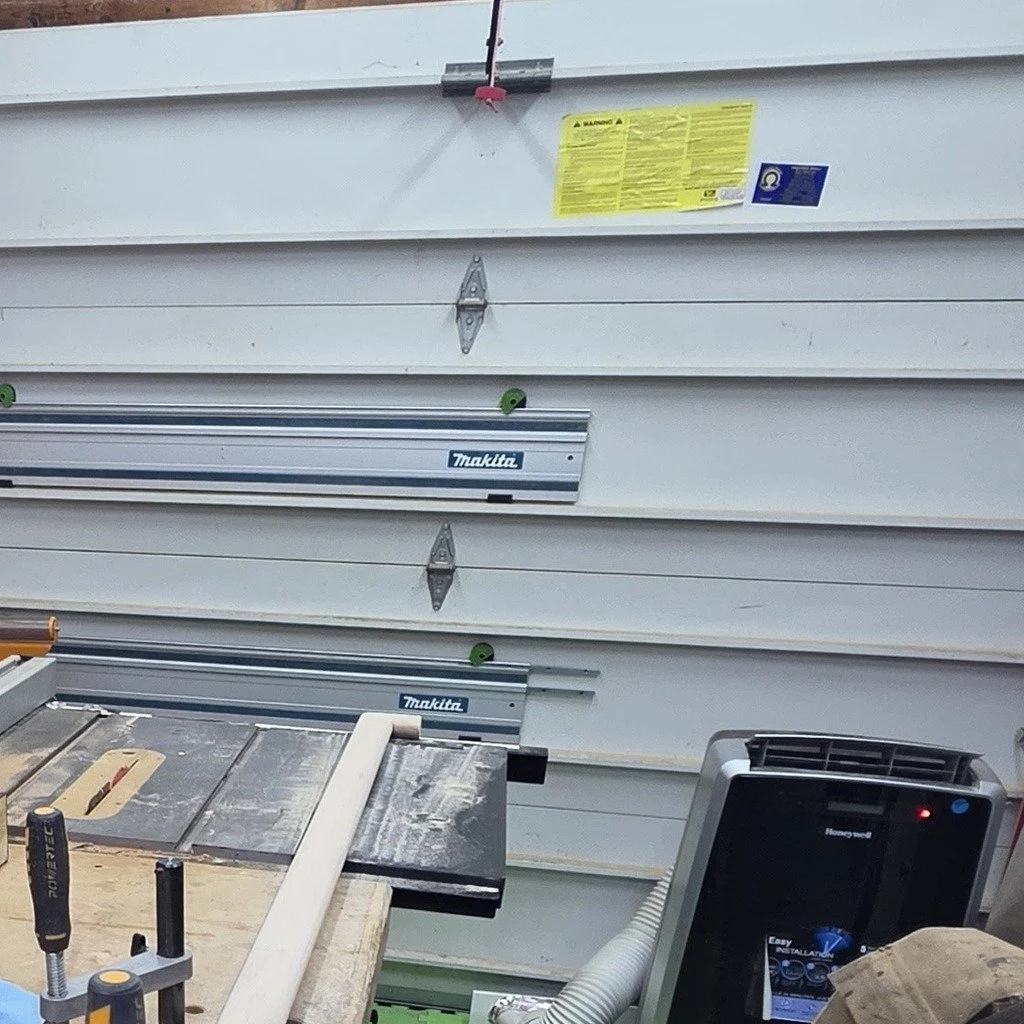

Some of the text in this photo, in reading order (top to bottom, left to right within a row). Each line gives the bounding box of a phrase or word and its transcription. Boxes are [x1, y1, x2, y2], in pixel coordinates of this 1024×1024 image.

[825, 827, 872, 839] Honeywell
[44, 827, 59, 899] POWERTEC
[768, 936, 792, 947] Easy
[776, 947, 834, 959] INSTALLATION
